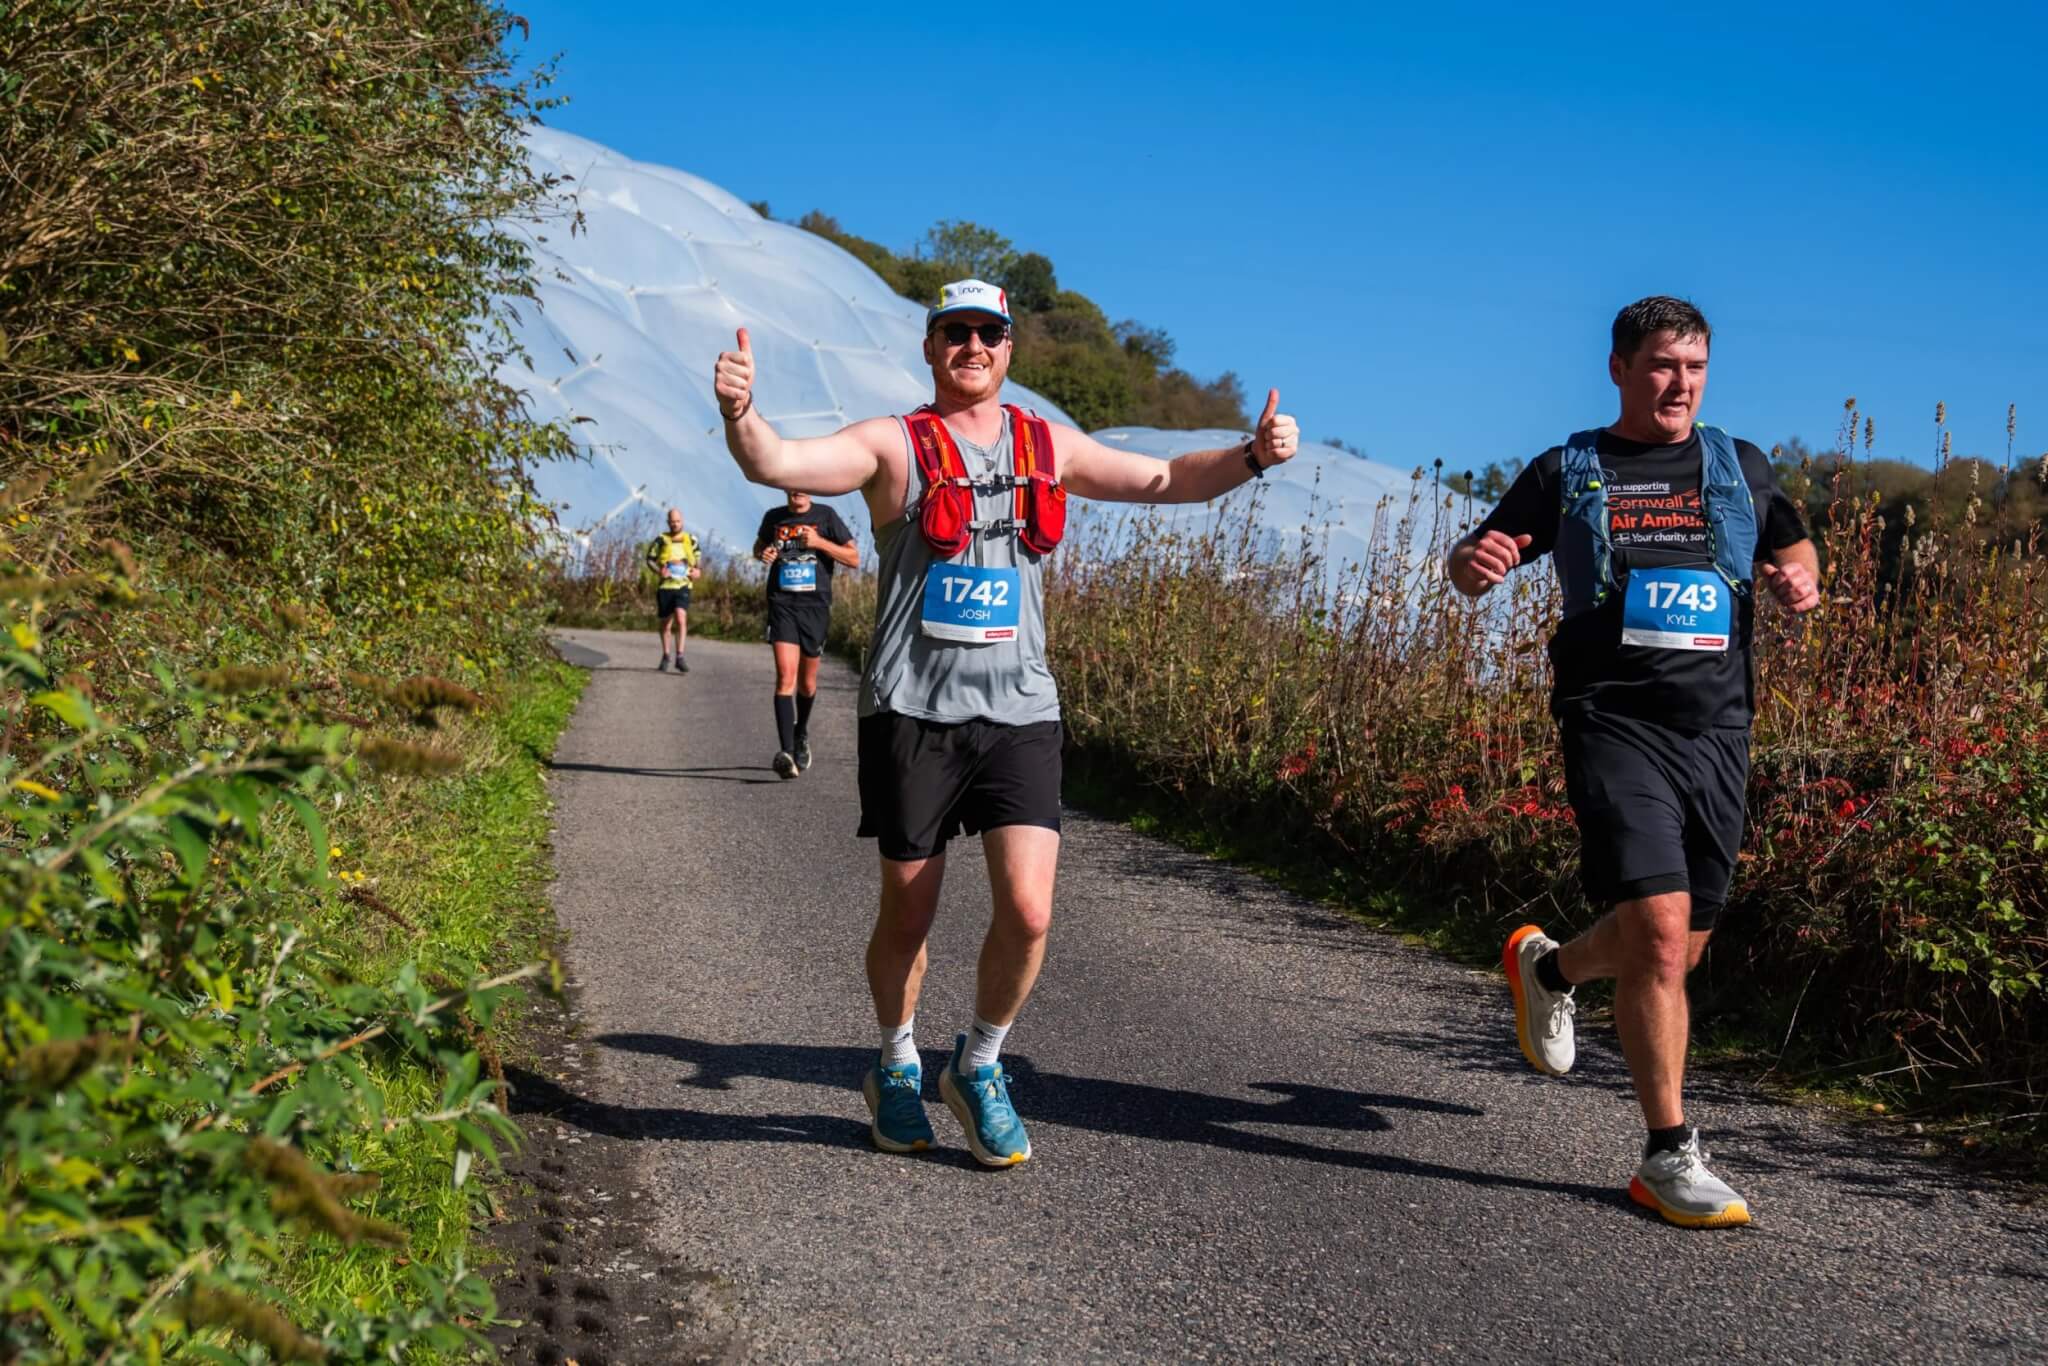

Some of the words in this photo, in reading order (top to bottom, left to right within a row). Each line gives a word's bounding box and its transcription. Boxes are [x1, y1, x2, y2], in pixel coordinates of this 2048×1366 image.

[1608, 484, 1621, 492] I'm
[1622, 482, 1670, 492] supporting
[1608, 495, 1684, 510] Cornwall
[1611, 513, 1638, 530] Air
[1632, 533, 1653, 542] Your
[1654, 531, 1688, 543] charity,
[784, 568, 810, 579] 1324
[942, 576, 1009, 606] 1742
[1645, 581, 1717, 612] 1743
[958, 608, 991, 620] JOSH
[1666, 614, 1698, 626] KYLE
